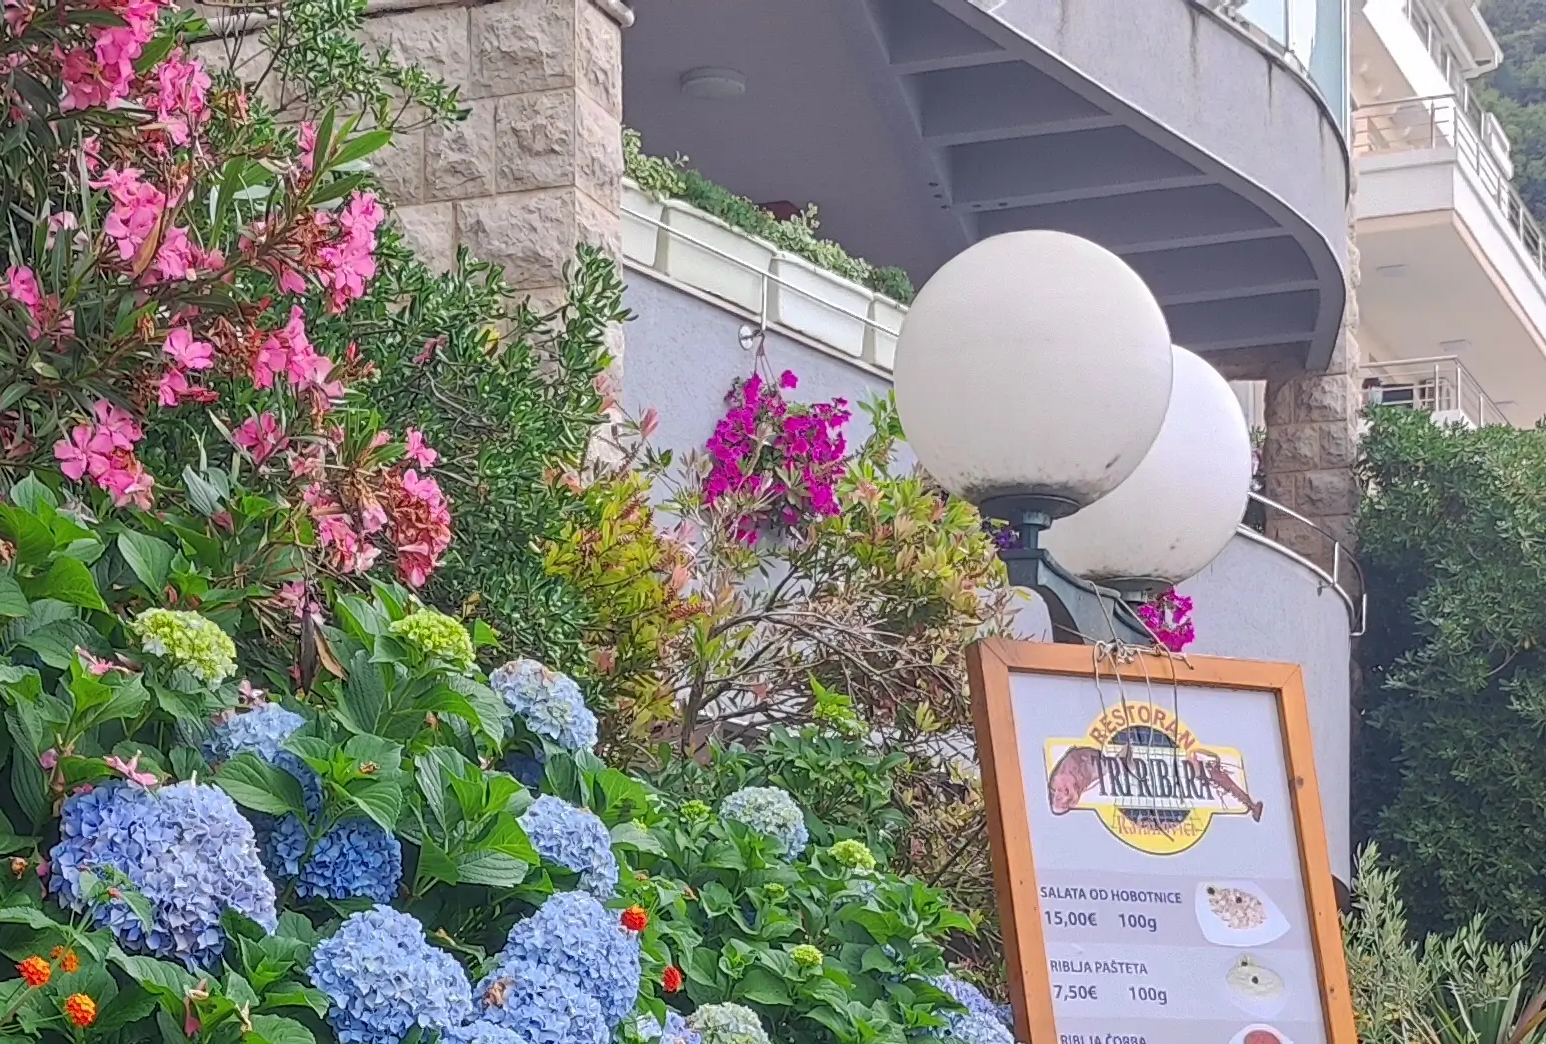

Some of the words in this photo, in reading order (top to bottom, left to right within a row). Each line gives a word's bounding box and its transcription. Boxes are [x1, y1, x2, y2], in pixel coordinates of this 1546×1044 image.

[1089, 706, 1196, 750] RESTORAN
[1092, 755, 1131, 796] TRI
[1132, 758, 1216, 800] RIBARA
[1040, 886, 1086, 901] SALATA
[1089, 888, 1108, 902] OD
[1111, 888, 1182, 904] HOBOTNICE
[1044, 911, 1097, 929] 15,00€
[1118, 914, 1157, 931] 100g
[1050, 959, 1092, 975] RIBLJA
[1094, 957, 1148, 975] PAŠTETA
[1054, 985, 1098, 1002] 7,50€
[1129, 986, 1167, 1004] 100g
